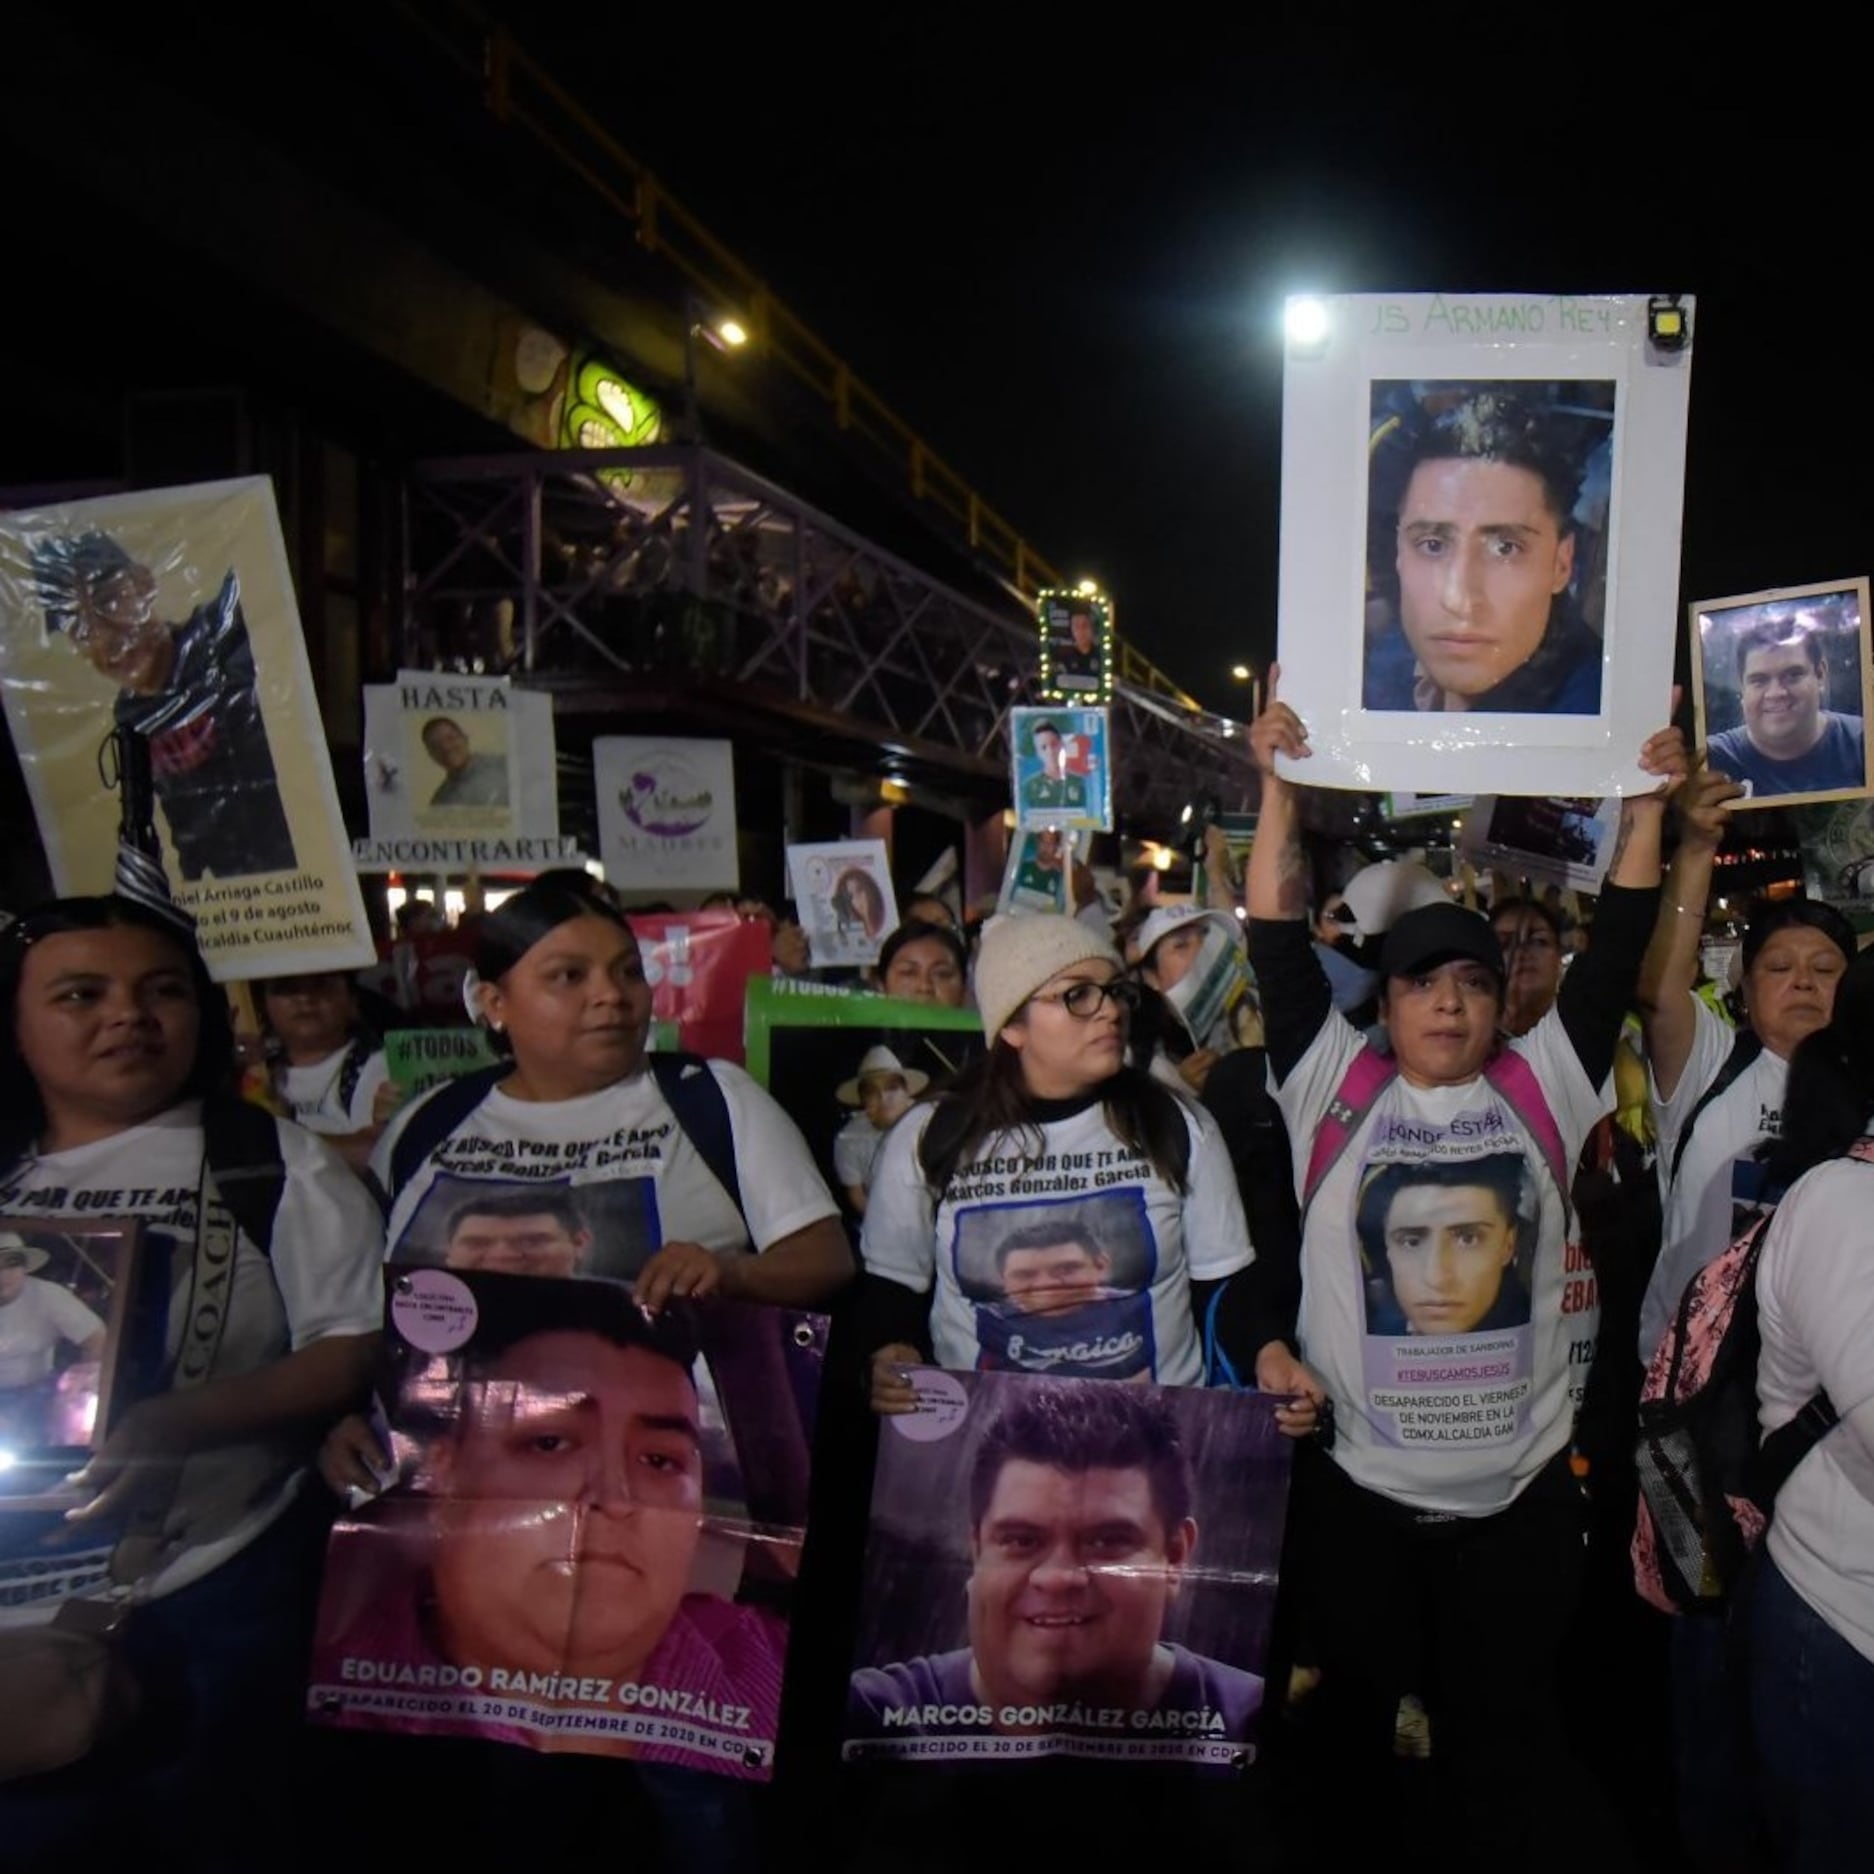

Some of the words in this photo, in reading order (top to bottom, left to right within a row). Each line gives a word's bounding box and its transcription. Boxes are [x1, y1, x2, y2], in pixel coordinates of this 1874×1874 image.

[402, 687, 508, 710] HASTA
[204, 885, 261, 904] Arriaga
[264, 875, 324, 896] Castillo
[213, 911, 226, 925] el
[230, 911, 240, 923] 9
[244, 907, 264, 921] de
[267, 902, 321, 922] agosto
[399, 1036, 478, 1060] #TODOS
[519, 1139, 559, 1157] POR
[1061, 1152, 1093, 1170] QUE
[1097, 1151, 1115, 1168] TE
[1010, 1174, 1088, 1196] González
[1094, 1164, 1151, 1187] García
[73, 1189, 124, 1210] QUE
[128, 1188, 158, 1208] TE
[184, 1200, 235, 1378] COACH
[1456, 1344, 1467, 1354] DE
[1374, 1394, 1460, 1408] DESAPARECIDO
[1463, 1394, 1477, 1406] EL
[1400, 1412, 1415, 1424] DE
[1418, 1409, 1486, 1424] NOVIEMBRE
[1486, 1408, 1500, 1421] EN
[1503, 1405, 1514, 1418] LA
[341, 1658, 482, 1687] EDUARDO
[491, 1667, 613, 1703] RAMÍREZ
[618, 1681, 751, 1729] GONZÁLEZ
[459, 1702, 477, 1714] EL
[483, 1703, 502, 1717] 20
[507, 1706, 527, 1720] DE
[531, 1710, 629, 1734] SEPTIEMBRE
[634, 1722, 655, 1735] DE
[660, 1724, 695, 1742] 2020
[699, 1734, 717, 1748] EN
[883, 1704, 993, 1727] MARCOS
[999, 1700, 1124, 1728] GONZÁLEZ
[1131, 1705, 1226, 1731] GARCÍA
[848, 1741, 968, 1758] DAPARECIDO
[973, 1741, 989, 1753] EL
[1015, 1741, 1033, 1753] DE
[1188, 1744, 1206, 1757] EN
